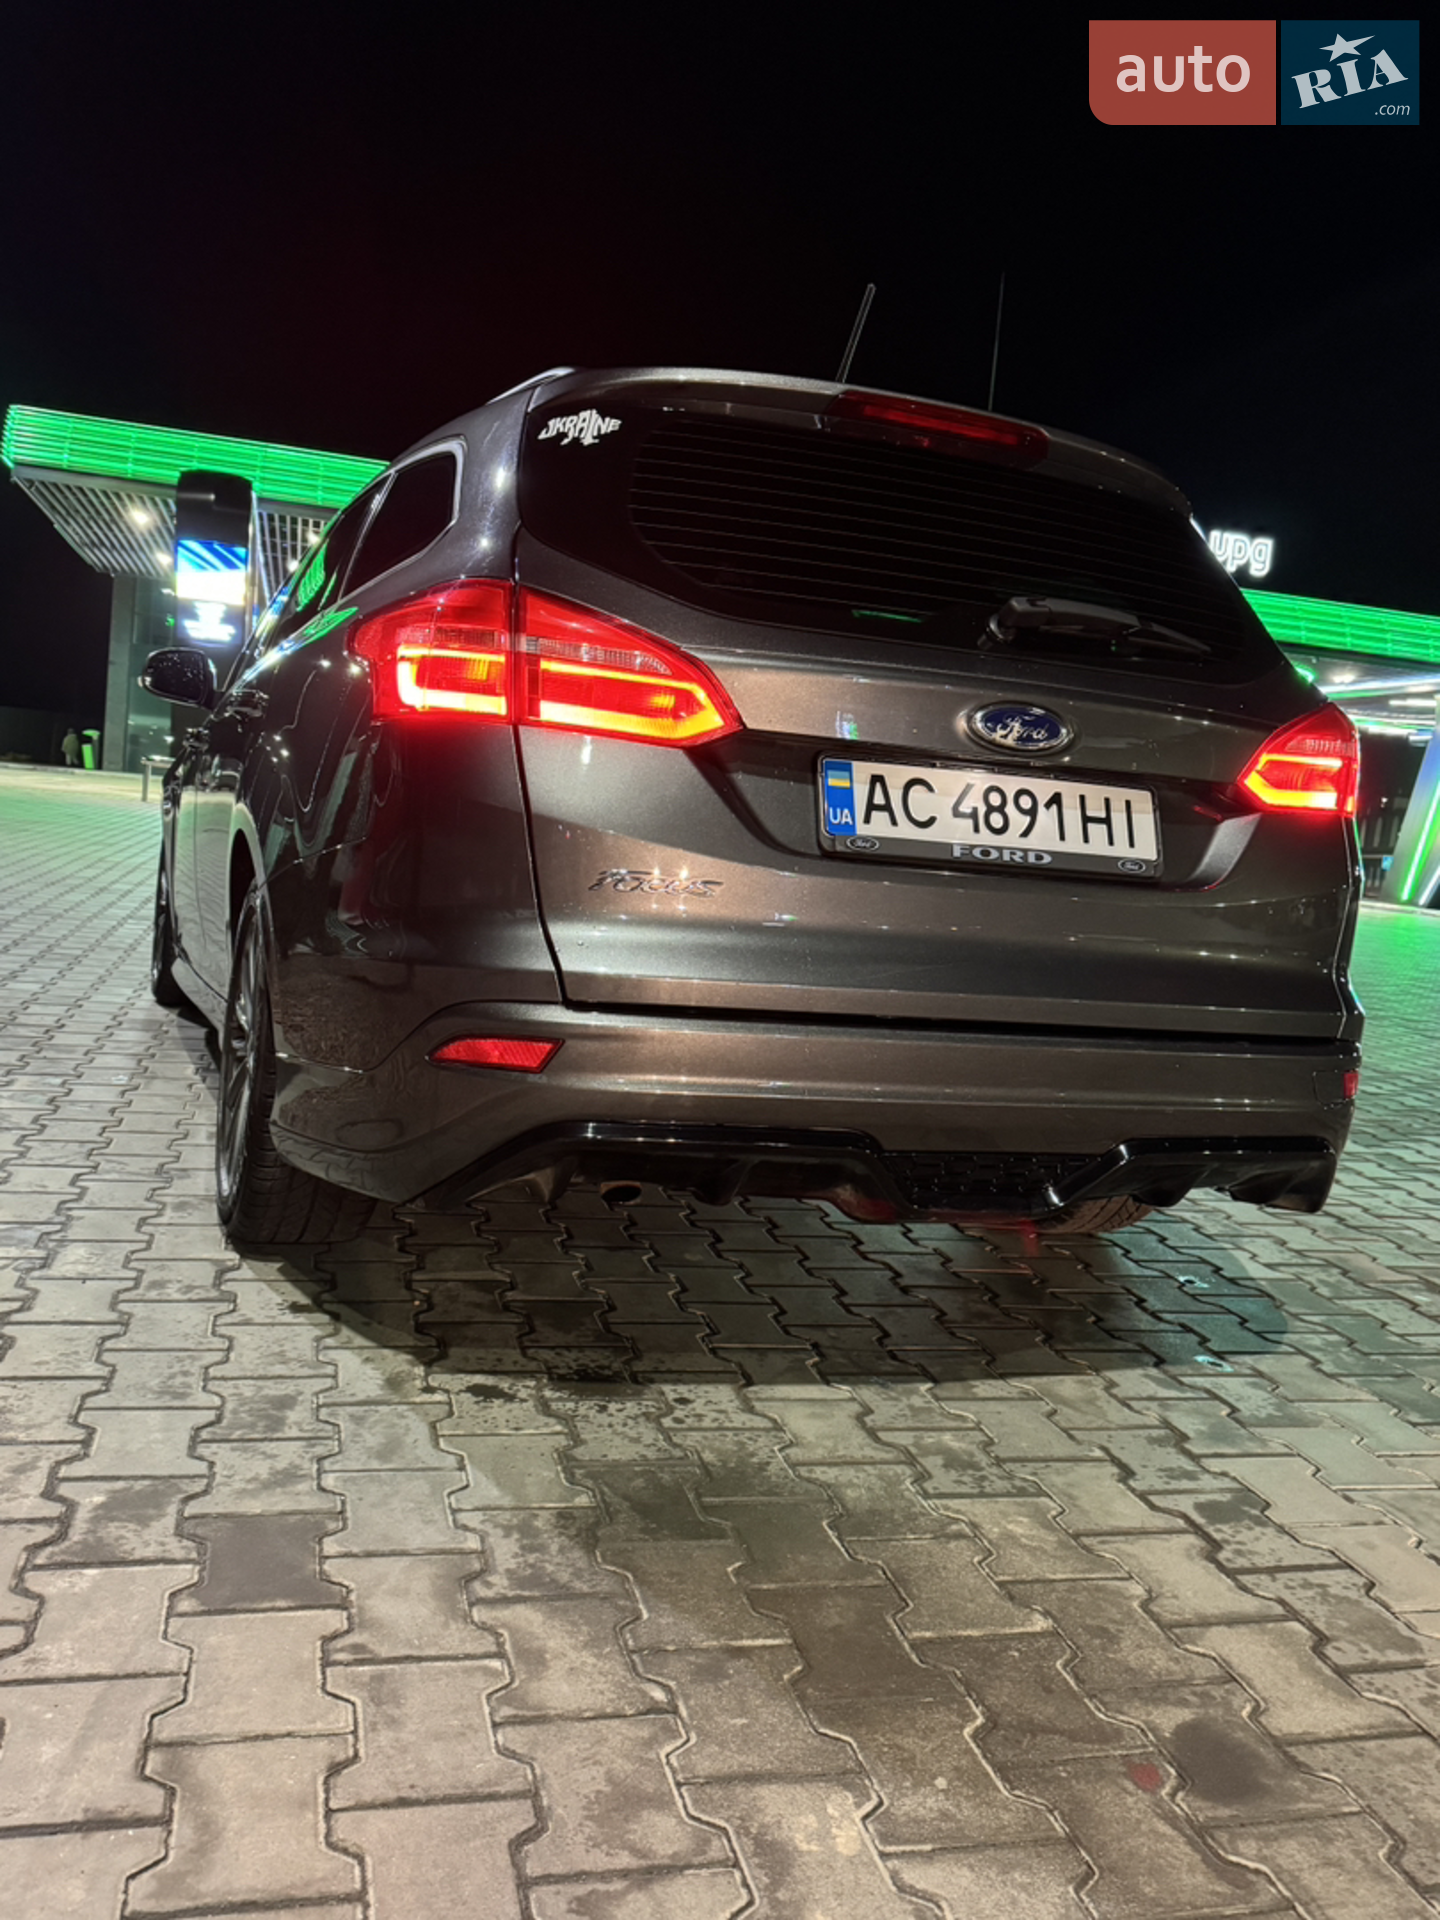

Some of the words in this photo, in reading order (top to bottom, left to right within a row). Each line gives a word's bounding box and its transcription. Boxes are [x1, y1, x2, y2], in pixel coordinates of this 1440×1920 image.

[1209, 530, 1273, 577] upg
[829, 808, 852, 825] UA
[863, 774, 937, 829] AC
[951, 783, 1065, 841] 4891
[1079, 794, 1135, 848] HI
[952, 844, 1052, 864] FORD
